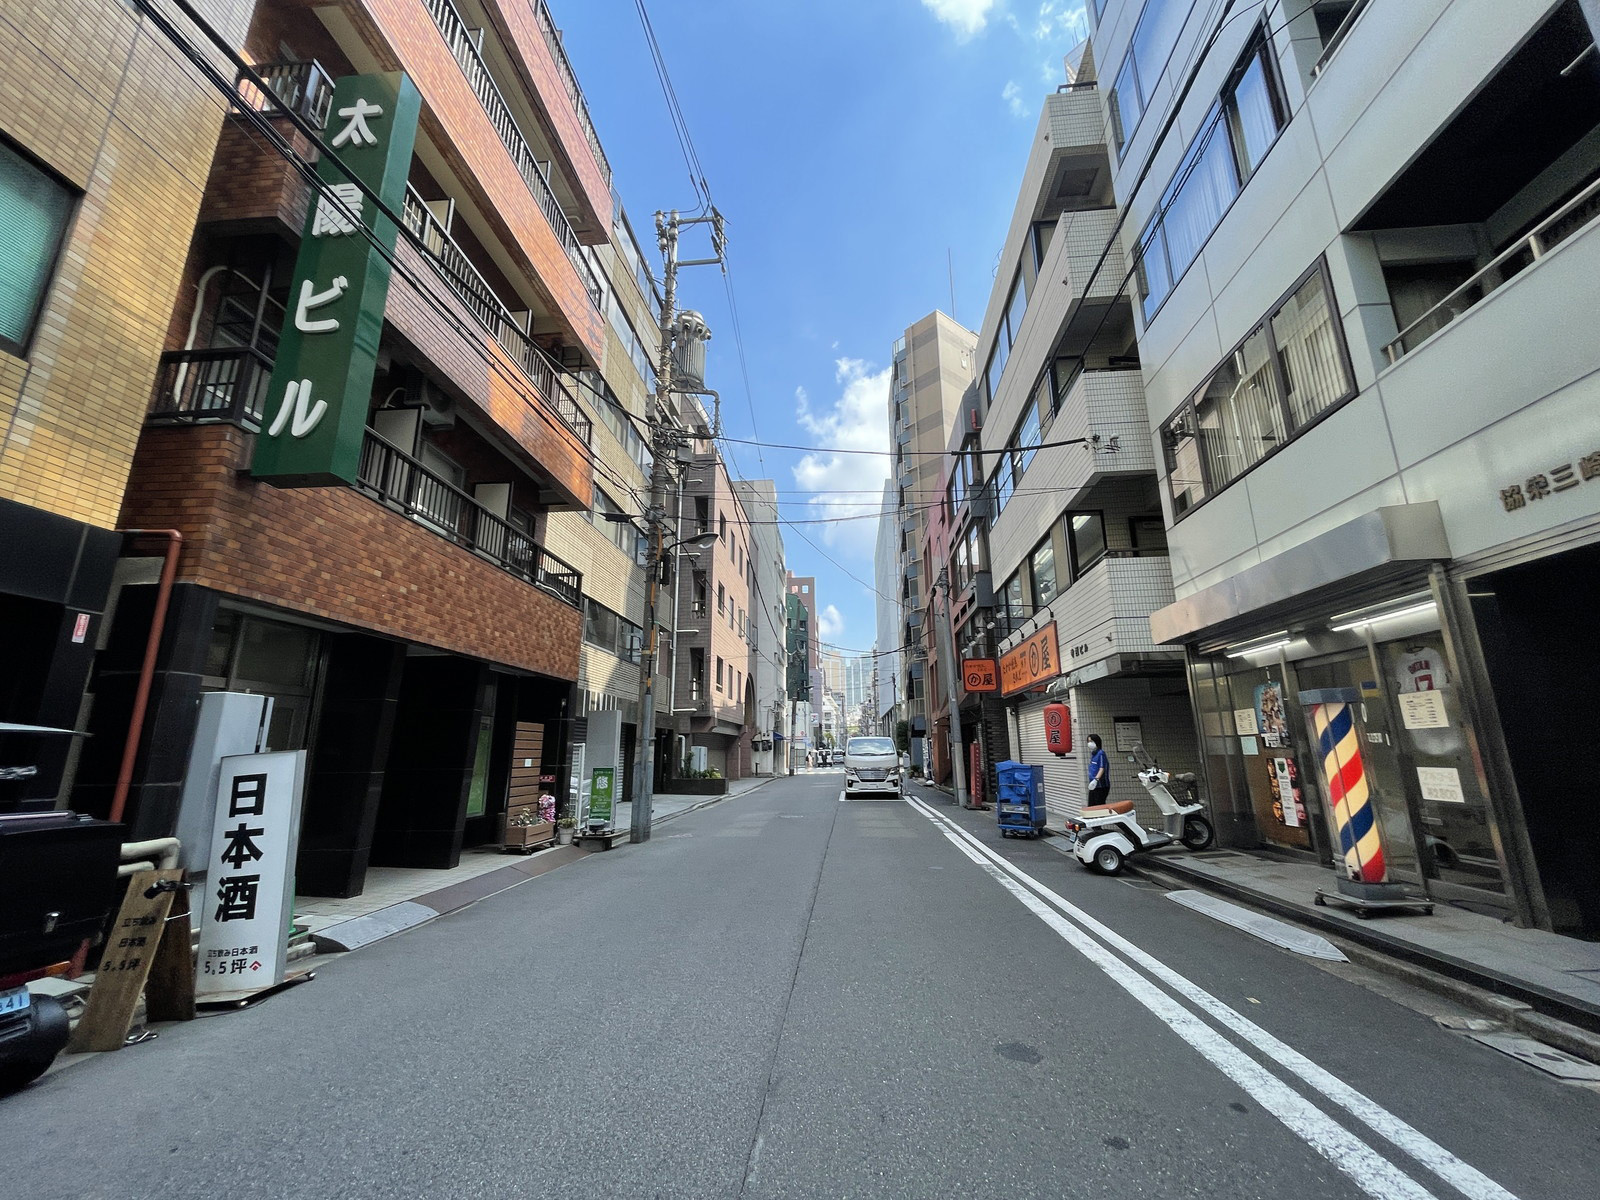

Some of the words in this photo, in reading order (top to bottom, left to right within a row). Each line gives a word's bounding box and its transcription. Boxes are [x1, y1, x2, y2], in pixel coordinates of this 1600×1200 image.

[268, 98, 384, 439] 太陽ビル
[214, 773, 268, 923] 日本酒
